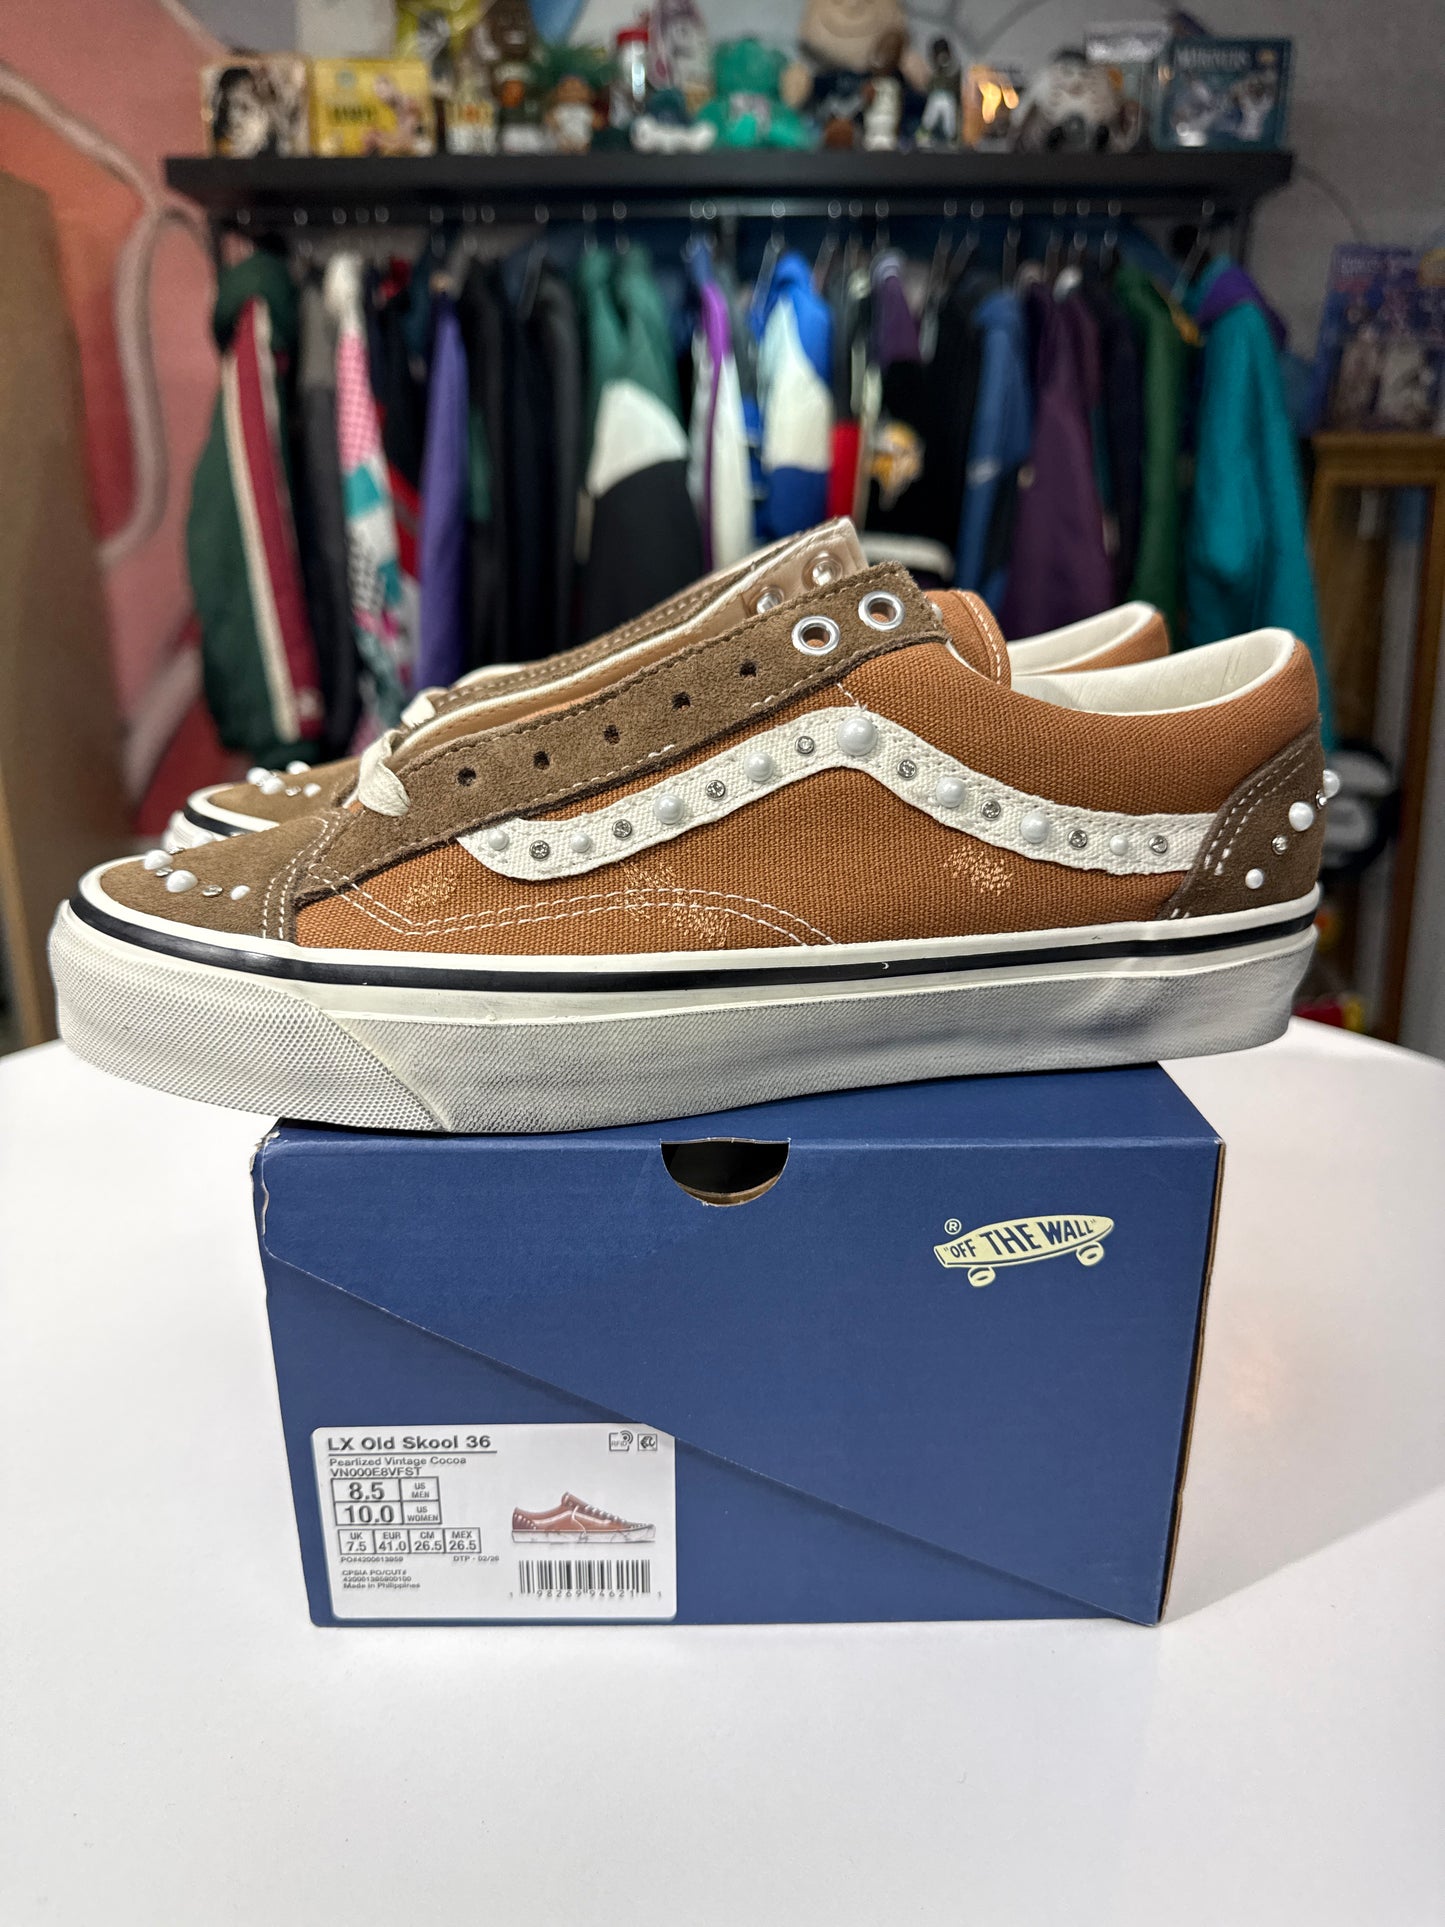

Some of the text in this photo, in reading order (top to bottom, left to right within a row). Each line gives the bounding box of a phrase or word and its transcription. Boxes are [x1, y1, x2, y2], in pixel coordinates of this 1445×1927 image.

[979, 1223, 1042, 1256] THE
[328, 1435, 491, 1451] LX Old Skool 36
[329, 1456, 467, 1467] Pearlized Vintage Cocoa
[330, 1467, 422, 1477] VN000E8VFST
[348, 1481, 385, 1500] 8.5
[414, 1482, 426, 1490] US
[411, 1491, 430, 1499] MEN
[344, 1505, 395, 1524] 10.0
[416, 1506, 428, 1514] US
[407, 1514, 439, 1522] WOMEN
[350, 1532, 362, 1540] UK
[420, 1531, 435, 1539] CM
[451, 1531, 472, 1539] MEX
[346, 1540, 477, 1551] 7.5 41.0 26.5 26.5
[377, 1582, 421, 1590] Philippines
